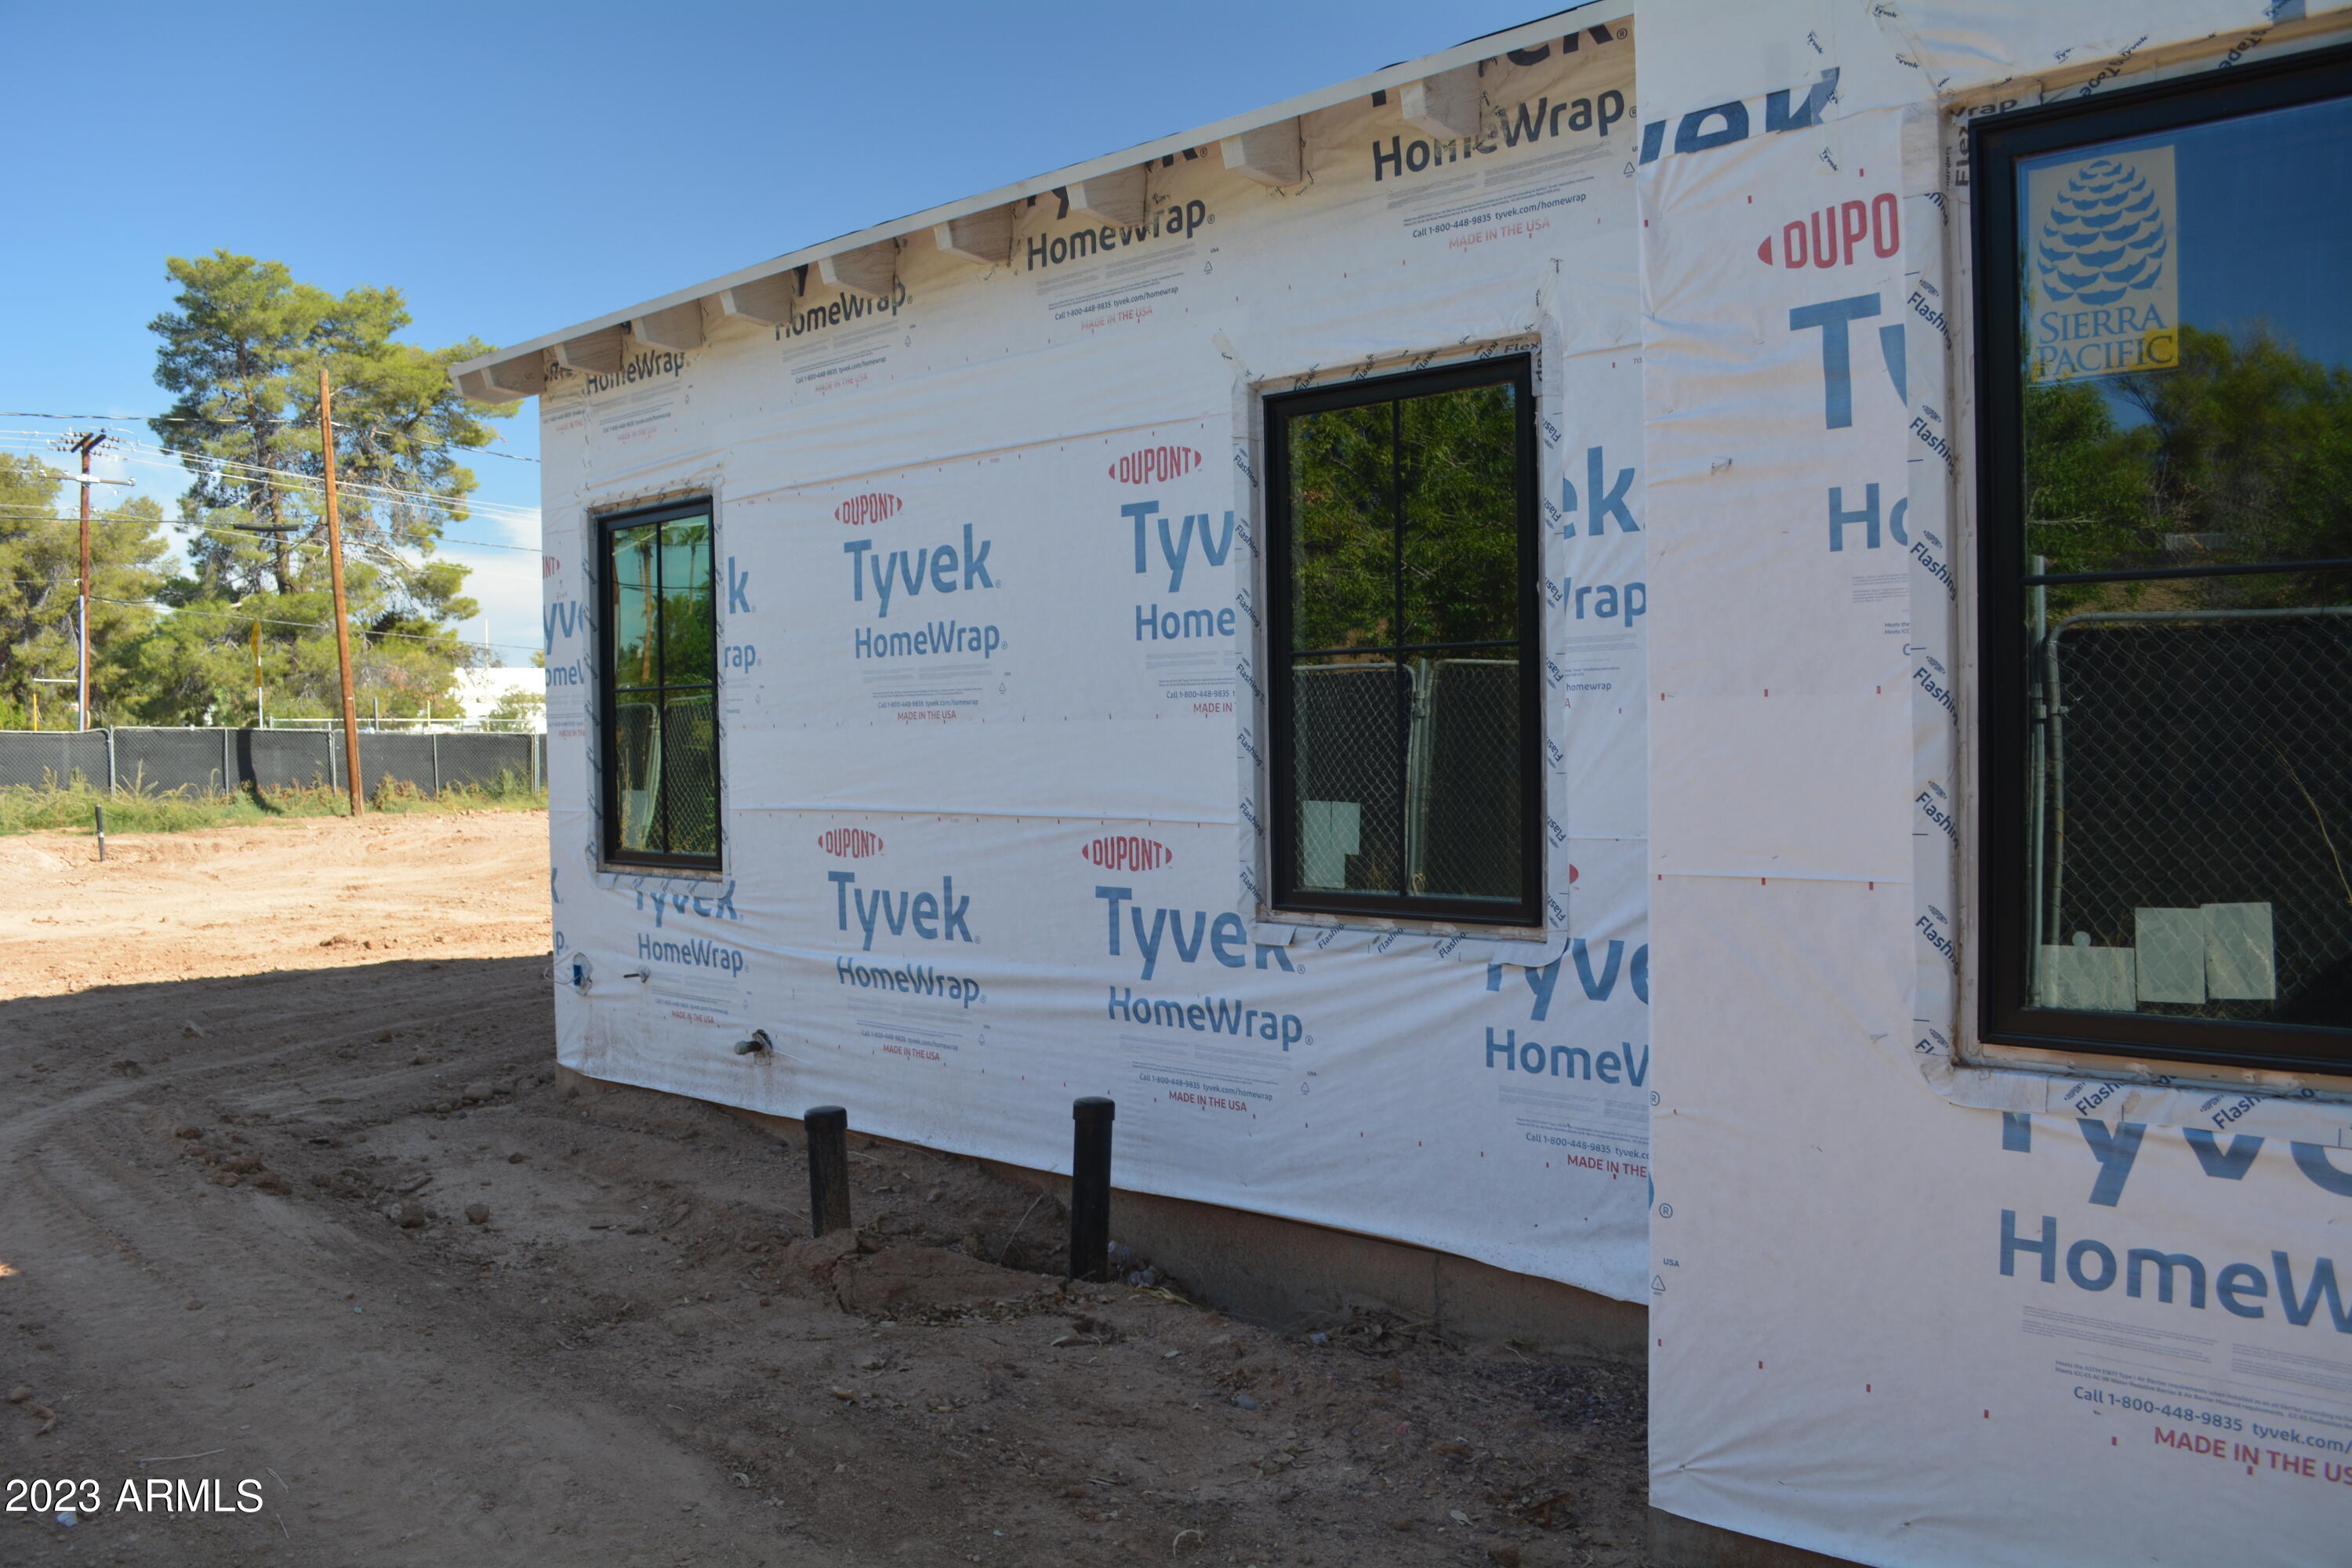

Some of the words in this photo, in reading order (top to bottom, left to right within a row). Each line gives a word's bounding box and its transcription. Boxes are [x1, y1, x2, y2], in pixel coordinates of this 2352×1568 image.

[1413, 221, 1427, 238] Call
[1428, 213, 1491, 234] 1-800-448-9835
[1494, 193, 1587, 220] tyvek.com/homewrap
[1449, 233, 1482, 249] MADE
[1486, 228, 1497, 241] IN
[1500, 223, 1523, 238] THE
[1526, 216, 1551, 232] USA
[1783, 193, 1900, 270] DUPO
[1081, 317, 1105, 330] MADE
[1107, 314, 1116, 325] IN
[1118, 310, 1134, 321] THE
[1135, 306, 1152, 318] USA
[2040, 303, 2167, 346] SIERRA
[2037, 334, 2173, 379] PACIFIC
[1120, 445, 1192, 485] DUPONT
[843, 492, 895, 525] DUPONT
[1121, 500, 1234, 593] Tyv
[728, 556, 751, 615] k
[844, 523, 993, 618] Tyvek
[855, 620, 1000, 659] HomeWrap
[1136, 604, 1236, 641] Home
[1566, 683, 1612, 691] homewrap
[897, 712, 917, 720] MADE
[927, 710, 941, 720] THE
[942, 710, 956, 720] USA
[1193, 702, 1220, 713] MADE
[1223, 702, 1232, 712] IN
[826, 828, 877, 859] DUPONT
[1092, 836, 1162, 872] DUPONT
[828, 870, 974, 952] Tyvek
[638, 933, 743, 977] HomeWrap
[836, 956, 980, 1009] HomeWrap
[1109, 985, 1303, 1052] HomeWrap
[883, 1044, 902, 1055] MADE
[903, 1047, 911, 1055] IN
[912, 1048, 925, 1058] THE
[926, 1051, 941, 1061] USA
[1169, 1091, 1195, 1104] MADE
[1197, 1094, 1207, 1105] IN
[1209, 1096, 1226, 1109] THE
[1229, 1100, 1247, 1112] USA
[1568, 1154, 1603, 1171] MADE
[1606, 1160, 1620, 1174] IN
[1622, 1162, 1647, 1178] THE
[1663, 1258, 1679, 1268] USA
[2073, 1386, 2103, 1403] Call
[2107, 1393, 2242, 1432] 1-800-448-9835
[2154, 1427, 2227, 1459] MADE
[2234, 1443, 2259, 1465] IN
[2266, 1450, 2316, 1477] THE
